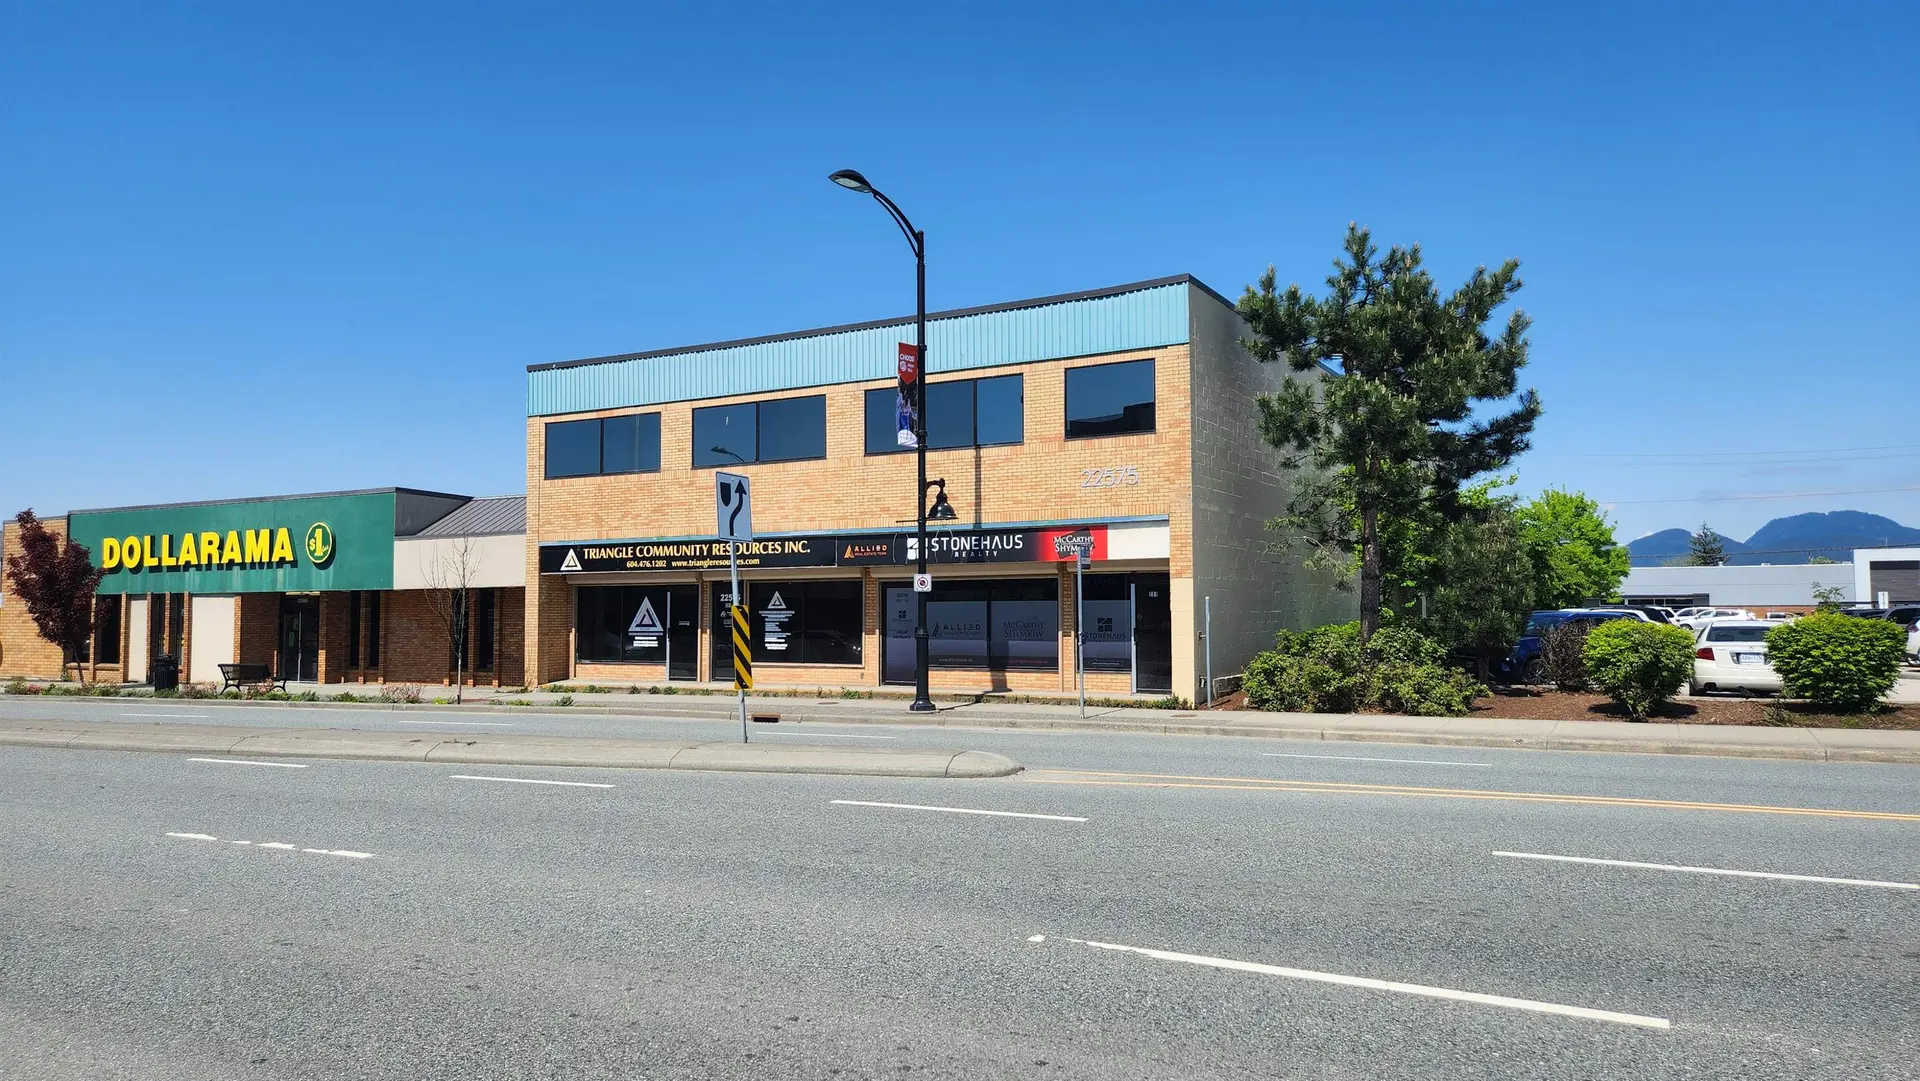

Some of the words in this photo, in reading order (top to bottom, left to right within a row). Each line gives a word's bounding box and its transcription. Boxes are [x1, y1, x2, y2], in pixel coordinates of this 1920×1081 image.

[1081, 466, 1139, 488] 22575
[103, 527, 294, 568] DOLLARAMA
[583, 547, 634, 560] TRIANGLE
[636, 544, 709, 558] COMMUNITY
[785, 540, 811, 554] INC.
[854, 544, 888, 552] ALLIED
[931, 534, 1023, 551] STONEHAUS
[626, 560, 667, 568] 604.476.1202
[943, 623, 981, 631] ALLIED
